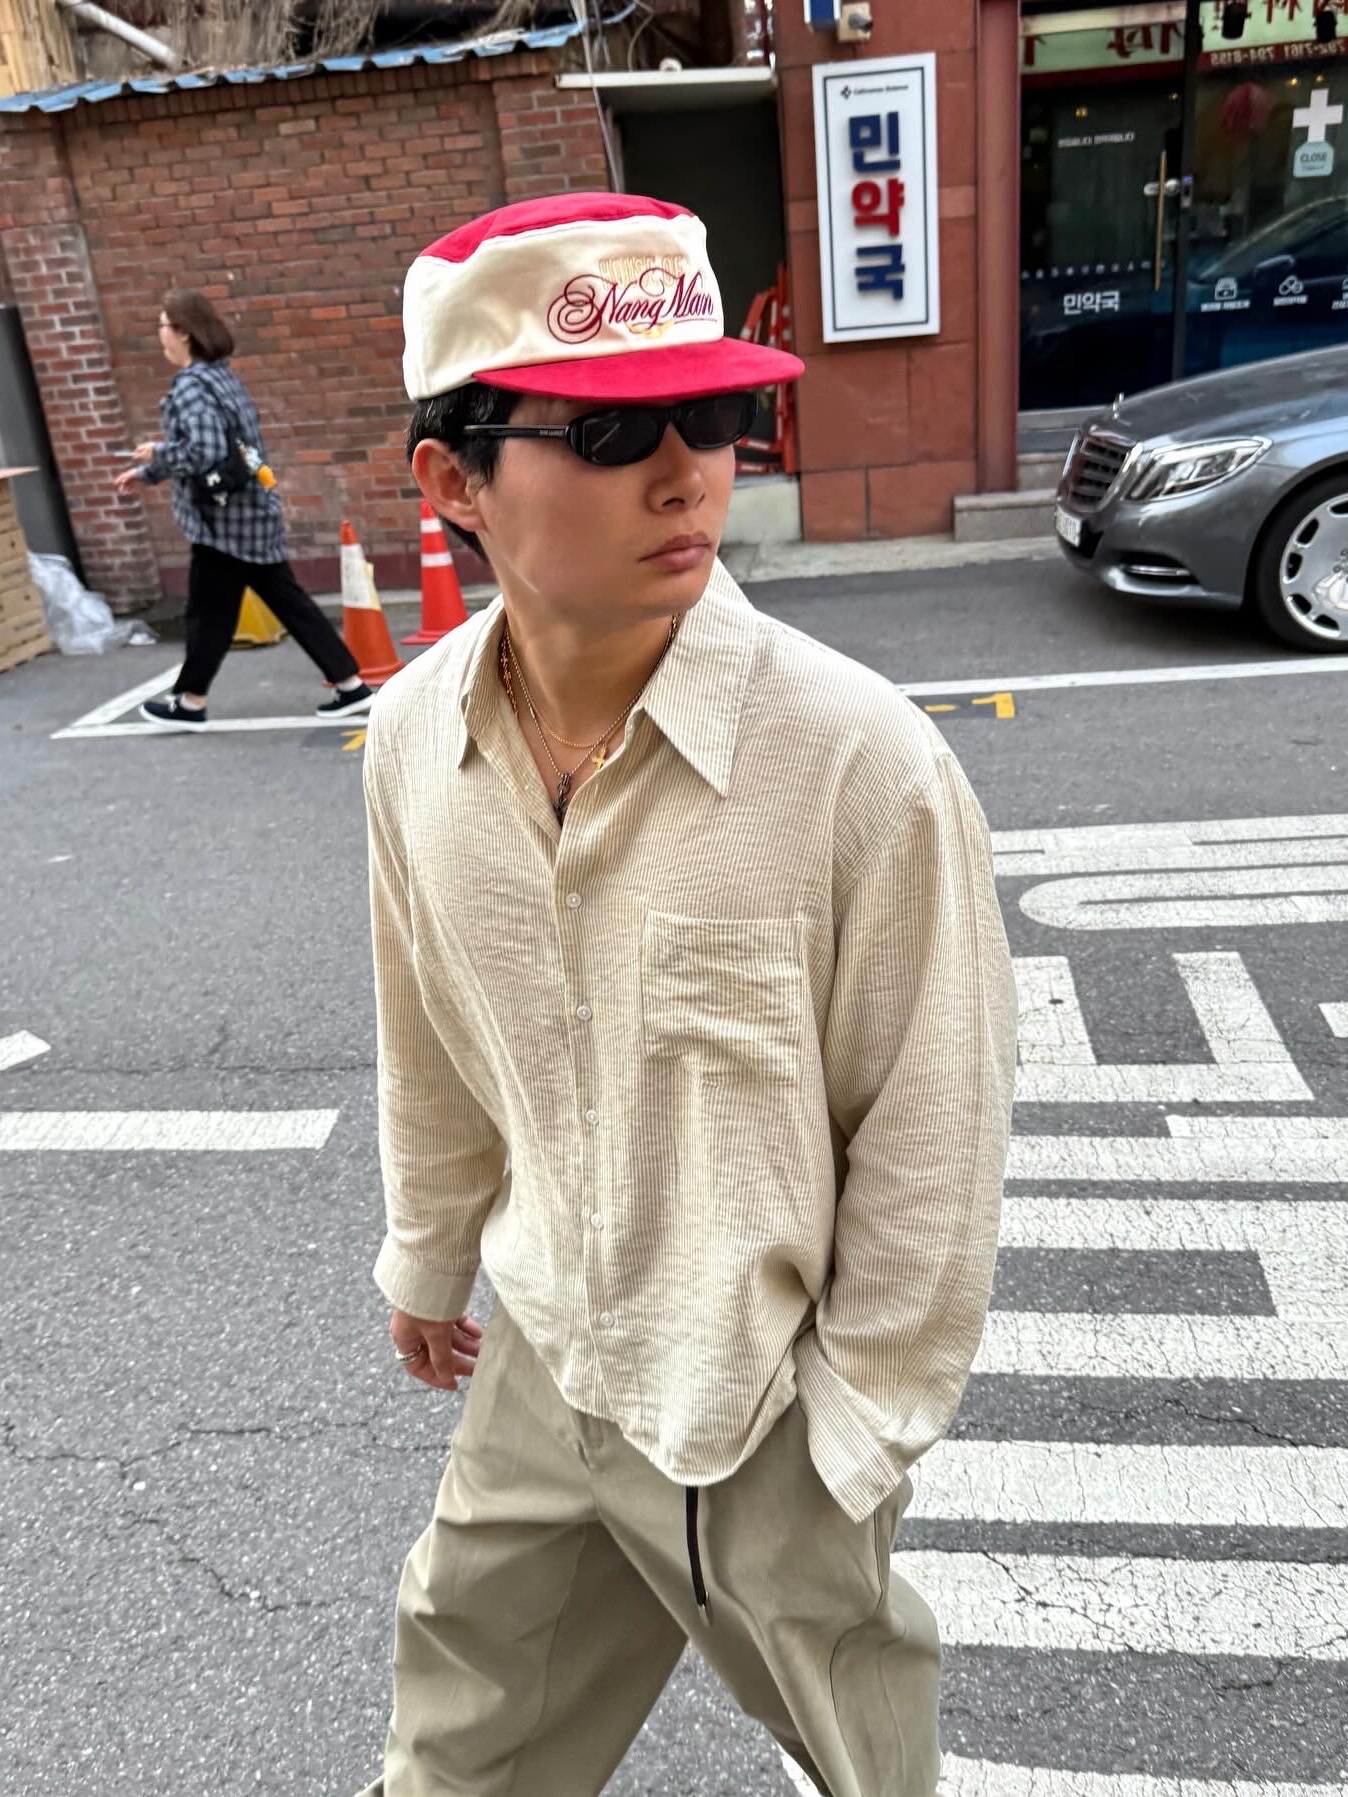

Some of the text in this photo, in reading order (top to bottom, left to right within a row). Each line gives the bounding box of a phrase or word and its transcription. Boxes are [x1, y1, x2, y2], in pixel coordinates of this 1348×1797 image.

[849, 111, 905, 300] 민약국
[547, 267, 714, 344] Nang Man
[1063, 289, 1120, 315] 민약국
